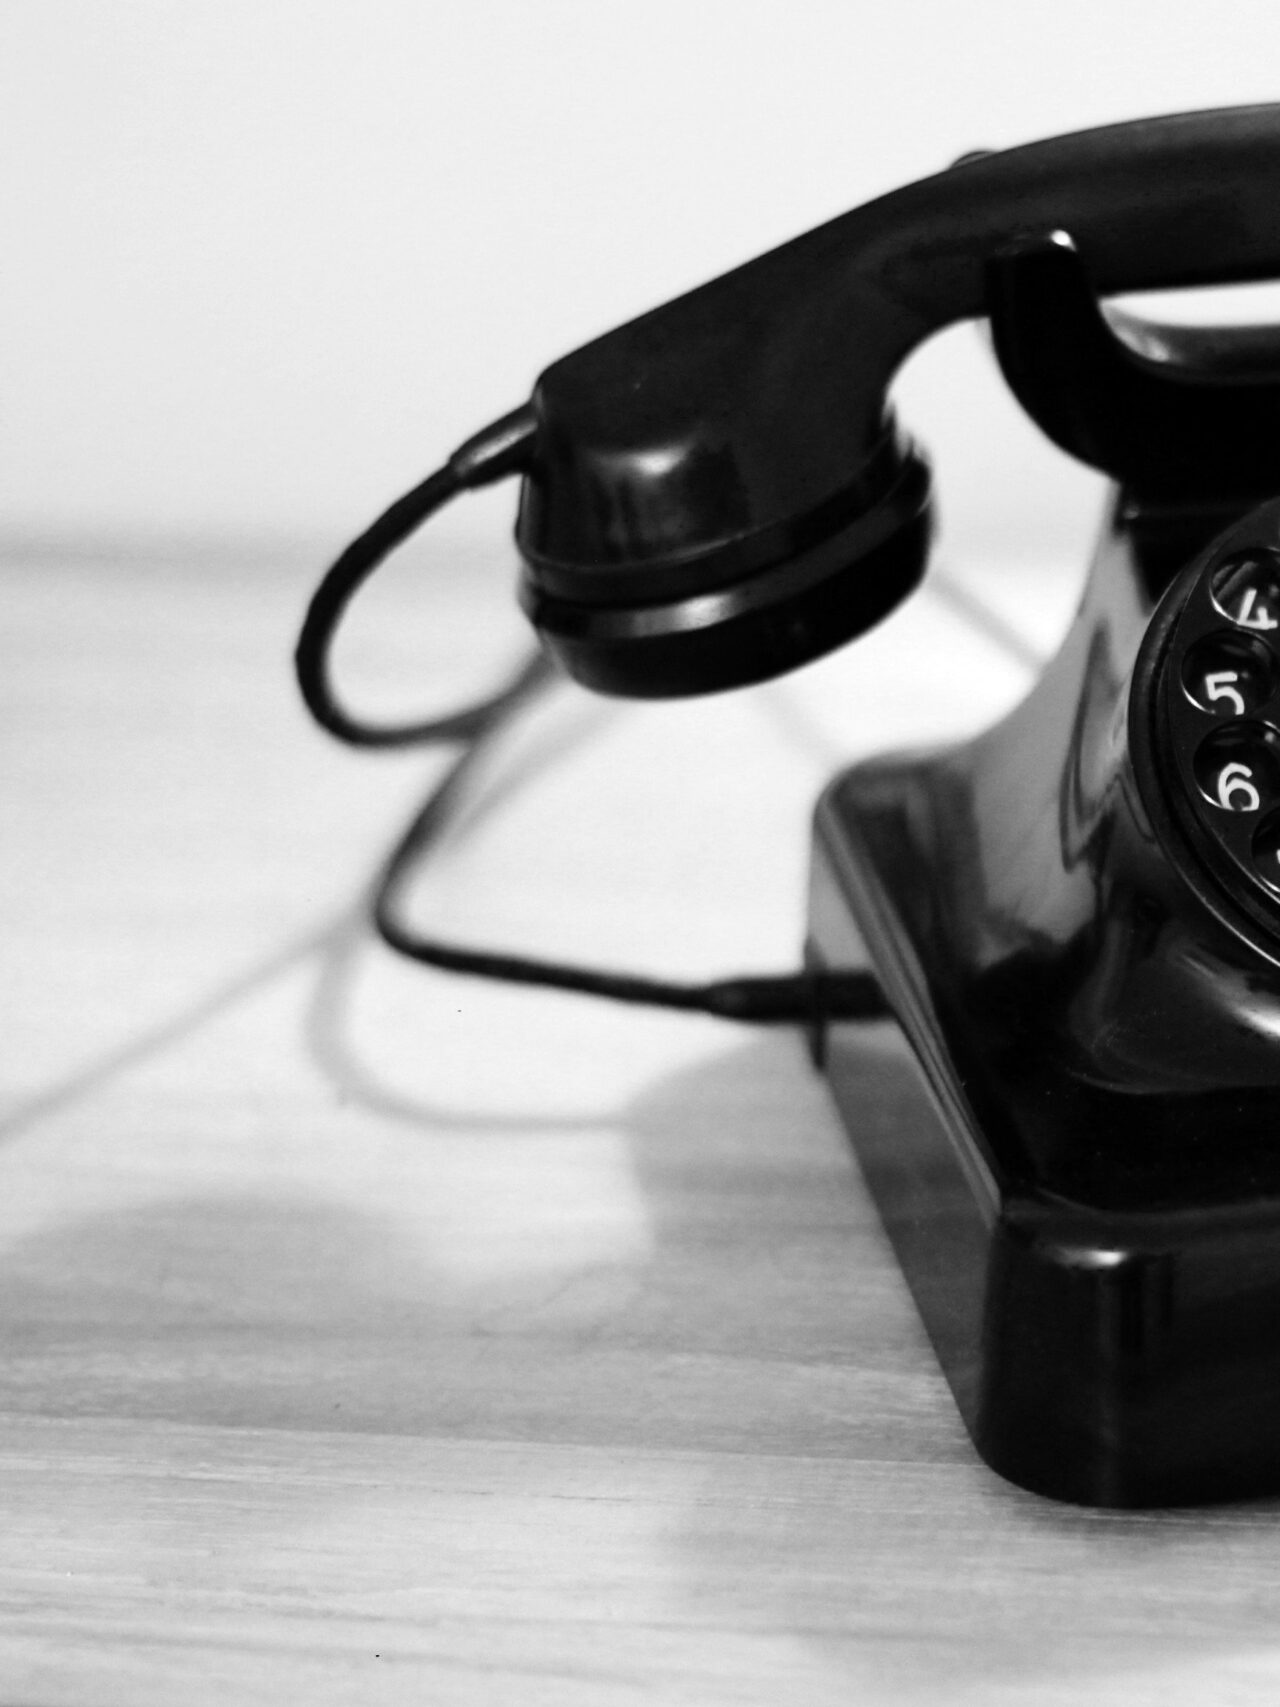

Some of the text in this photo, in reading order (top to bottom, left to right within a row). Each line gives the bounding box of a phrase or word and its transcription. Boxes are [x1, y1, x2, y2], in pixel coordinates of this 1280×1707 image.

[1238, 588, 1279, 631] 4
[1204, 670, 1246, 716] 5
[1216, 762, 1260, 811] 6
